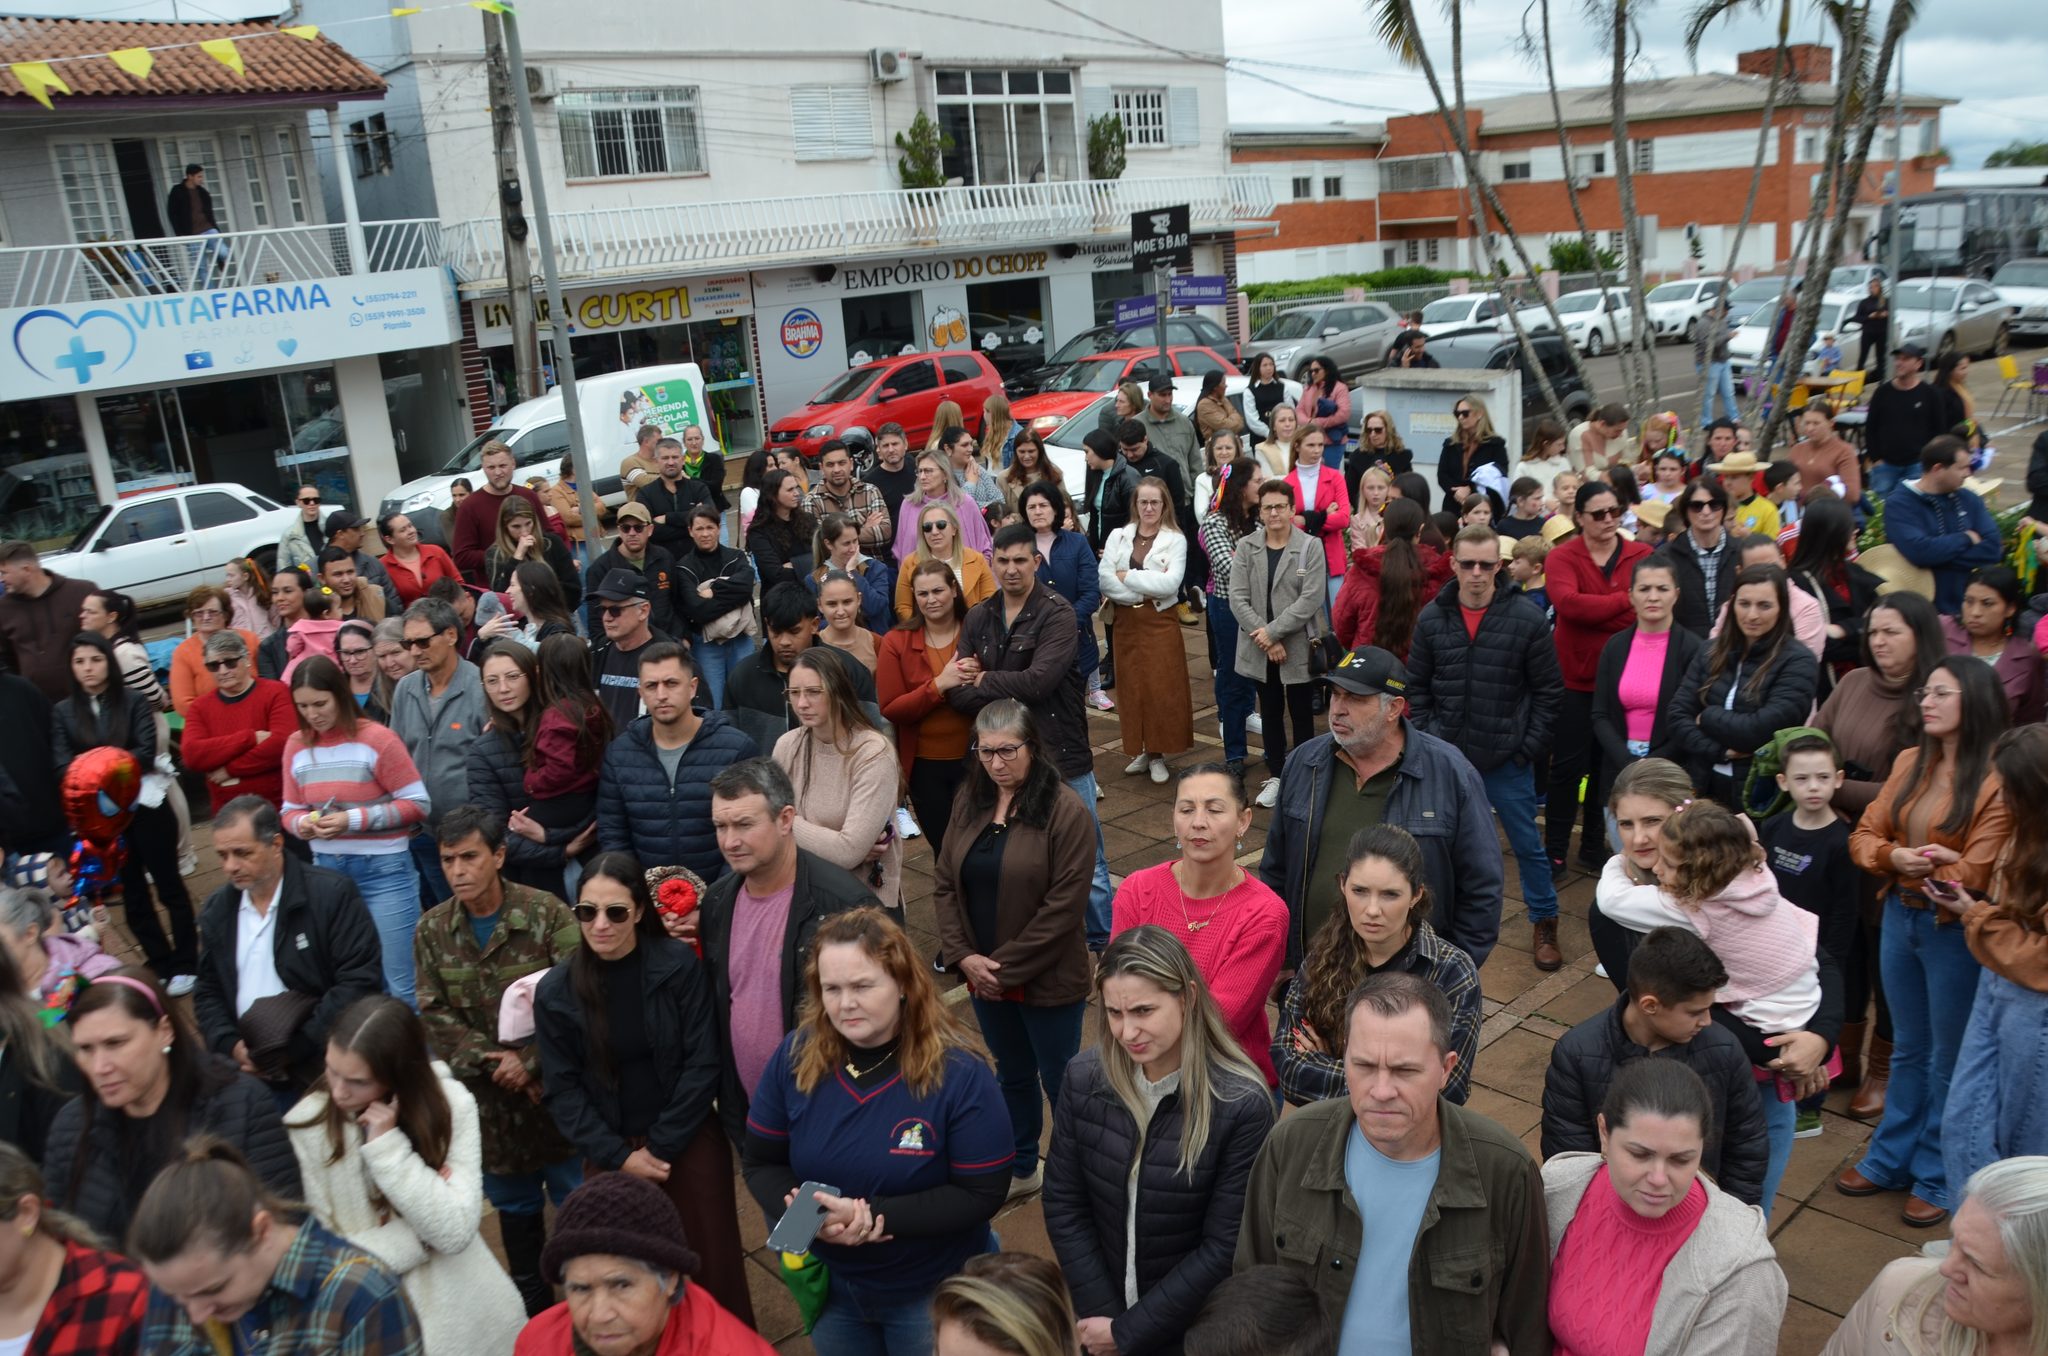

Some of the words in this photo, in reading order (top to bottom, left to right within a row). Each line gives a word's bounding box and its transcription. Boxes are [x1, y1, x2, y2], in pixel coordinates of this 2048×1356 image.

[1133, 237, 1165, 256] MOE'S
[1166, 233, 1188, 250] BAR
[843, 258, 950, 290] EMPÓRIO
[952, 256, 983, 279] DO
[986, 251, 1048, 275] CHOPP
[126, 284, 331, 329] VITAFARMA
[578, 287, 692, 329] CURTI
[182, 320, 295, 342] FARMACIA
[784, 325, 820, 341] BRAHMA
[313, 382, 332, 393] 846
[643, 400, 688, 417] MERENDA
[645, 410, 689, 426] ESCOLAR
